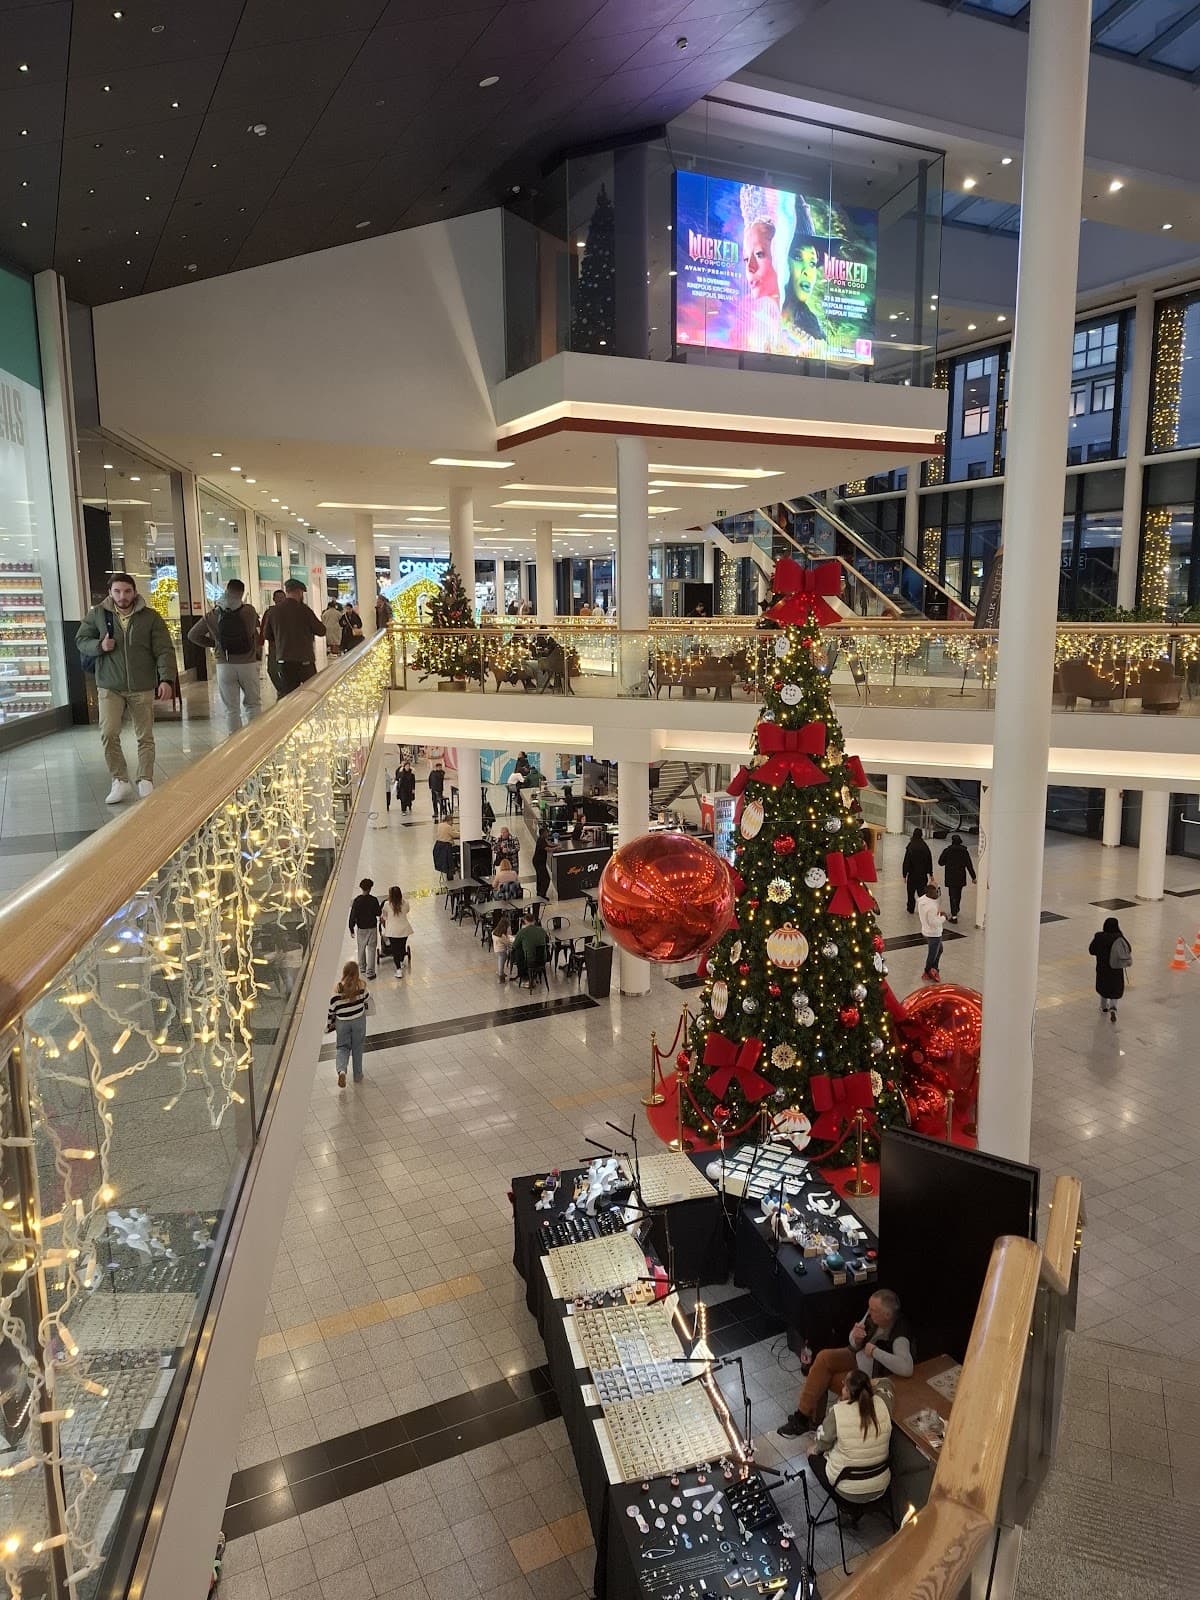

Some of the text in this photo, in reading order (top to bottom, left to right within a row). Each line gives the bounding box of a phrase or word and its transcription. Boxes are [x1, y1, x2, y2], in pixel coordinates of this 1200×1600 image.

[689, 228, 739, 262] WICKED
[715, 260, 736, 269] GOOD
[824, 252, 867, 284] WICKED
[833, 279, 865, 289] FOR GOOD
